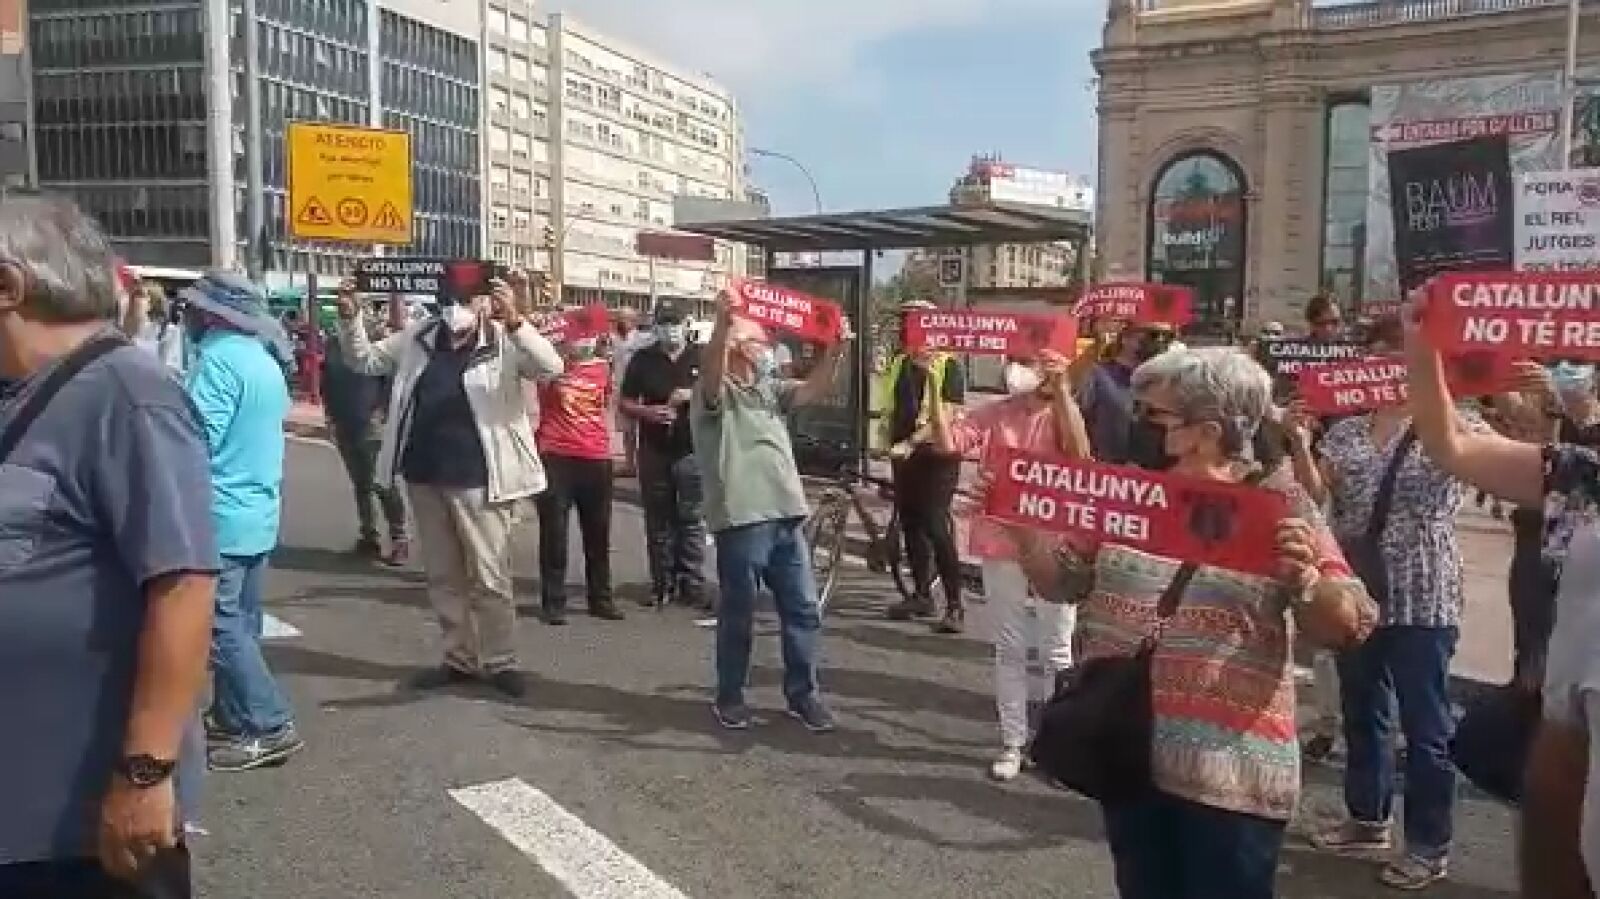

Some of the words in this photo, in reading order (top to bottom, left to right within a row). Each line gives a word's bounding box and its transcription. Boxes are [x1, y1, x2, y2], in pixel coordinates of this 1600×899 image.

[1524, 181, 1574, 196] FORA
[1524, 212, 1548, 226] EL
[362, 262, 446, 274] CATALUNYA
[370, 278, 391, 290] NO
[413, 278, 439, 291] REI
[743, 284, 812, 314] CATALUNYA
[749, 303, 766, 317] NO
[920, 314, 1018, 333] CATALUNYA
[1463, 316, 1509, 342] NO
[1517, 311, 1557, 345] TÉ
[925, 334, 949, 347] NO
[979, 335, 1008, 350] REI
[1334, 388, 1365, 405] NO
[1369, 381, 1396, 401] TÉ
[1010, 459, 1168, 509] CATALUNYA
[1018, 491, 1056, 519] NO
[1064, 498, 1096, 530] TÉ
[1103, 509, 1150, 540] REI
